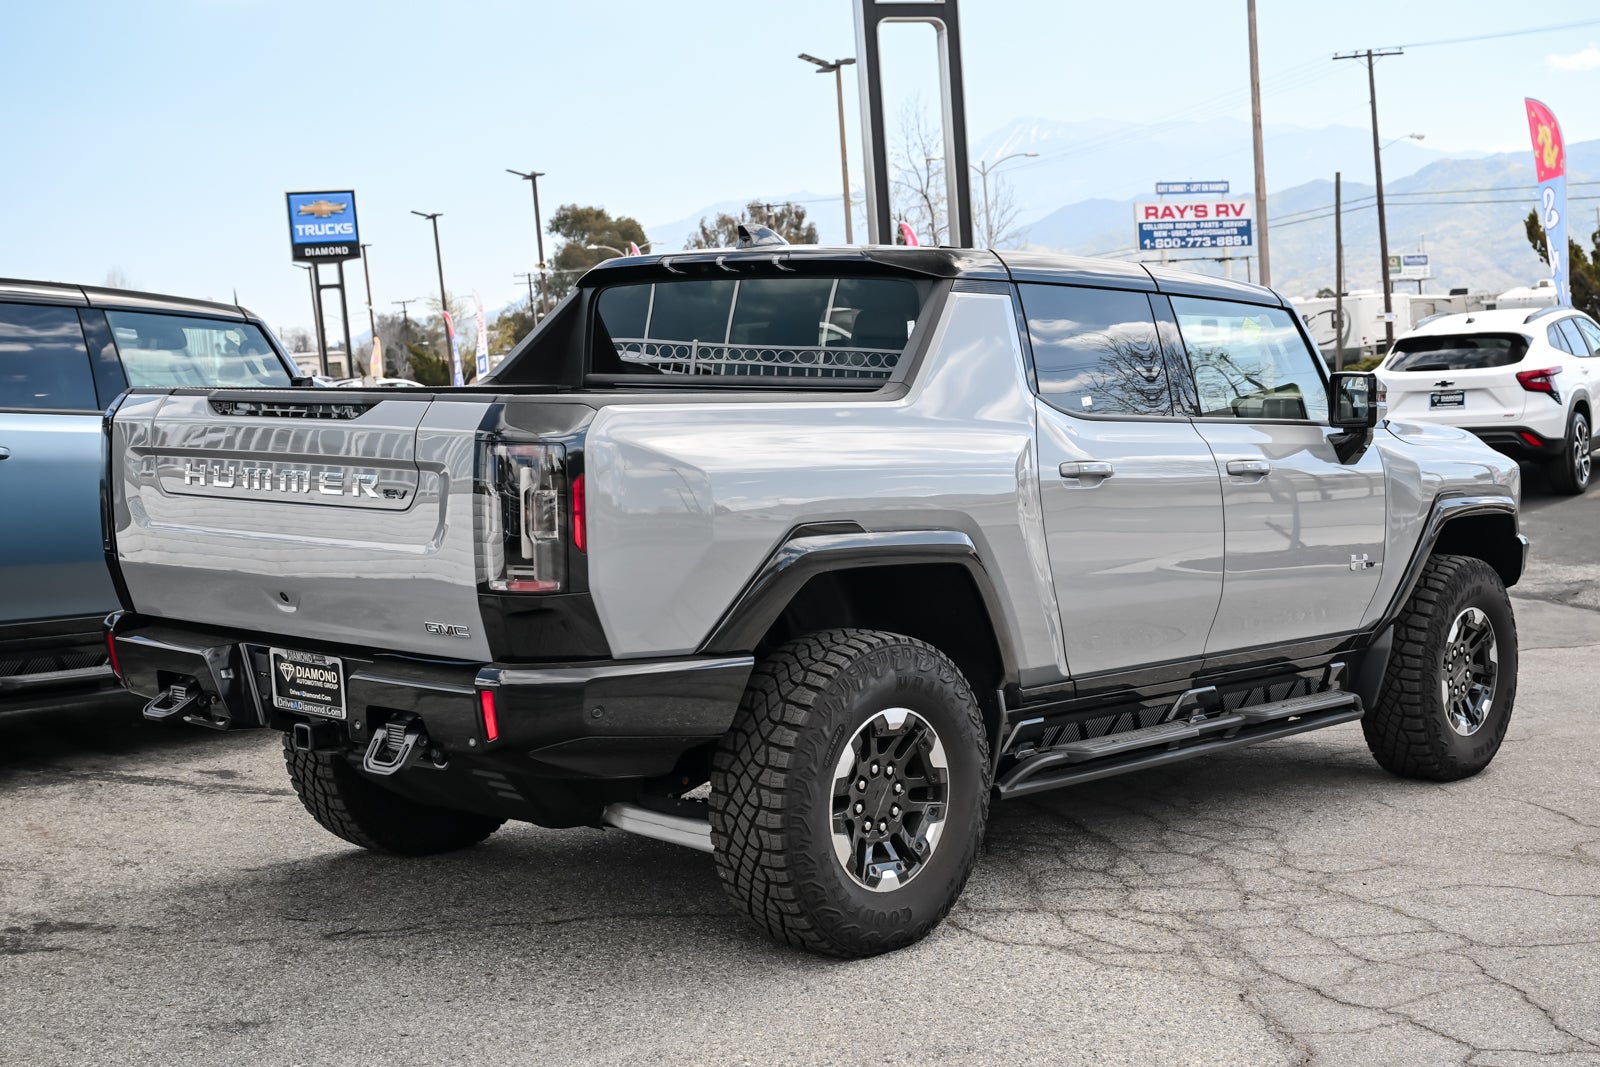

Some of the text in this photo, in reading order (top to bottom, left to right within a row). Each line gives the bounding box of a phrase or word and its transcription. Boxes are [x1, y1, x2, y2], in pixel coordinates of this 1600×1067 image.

[1144, 203, 1246, 220] RAY'S RV
[295, 222, 354, 236] TRUCKS
[1143, 222, 1174, 230] COLLISION
[304, 246, 349, 257] DIAMOND
[184, 463, 409, 500] HUMMER EV
[424, 621, 471, 639] GMC
[287, 650, 313, 663] DIAMOND
[296, 665, 338, 683] DIAMOND
[296, 678, 338, 690] AUTOMOTIVE GROUP
[290, 688, 331, 701] DriveADiamond.Com
[278, 698, 342, 717] DriveADiamond.Com
